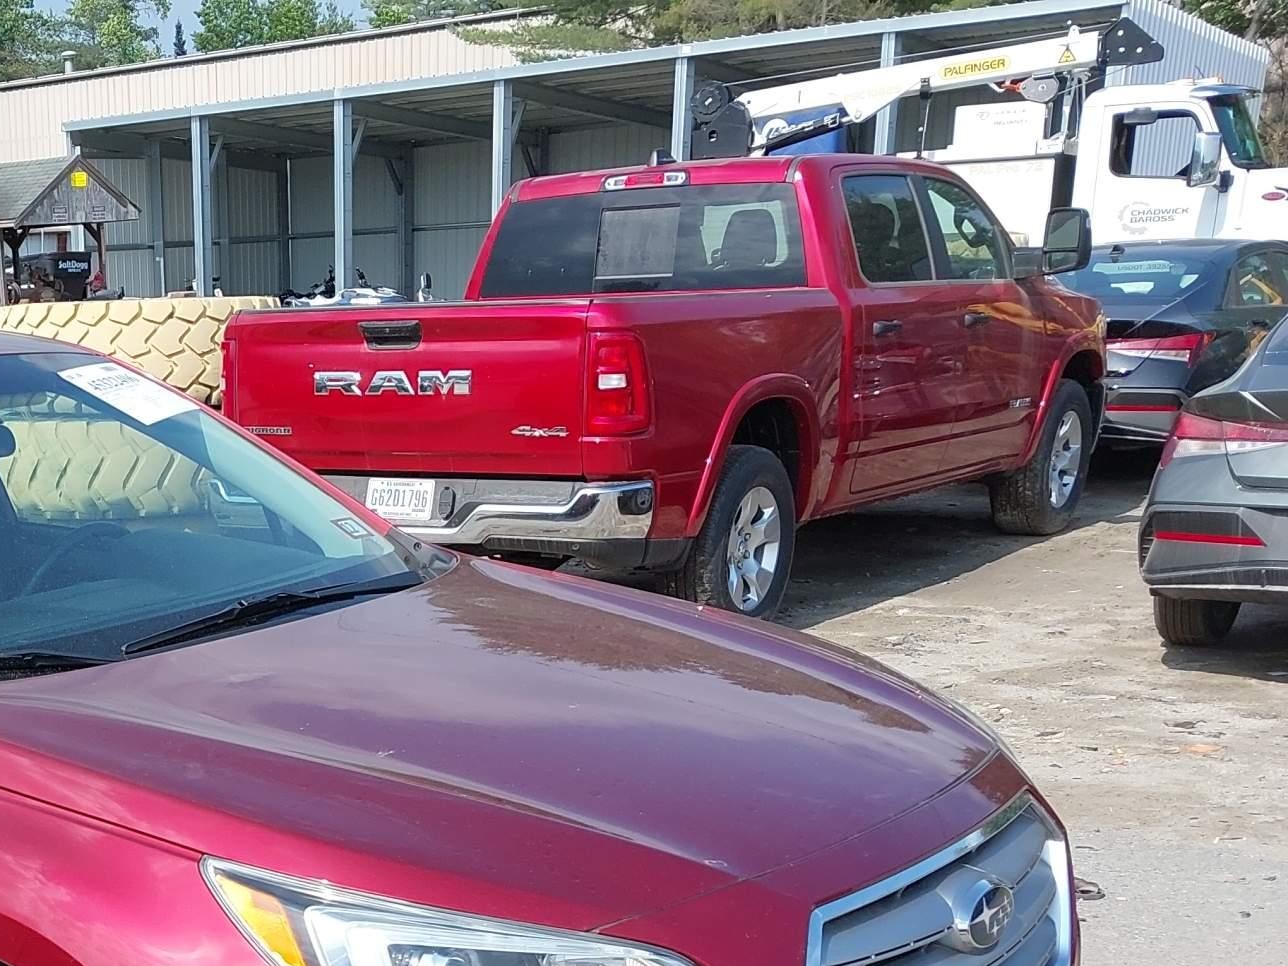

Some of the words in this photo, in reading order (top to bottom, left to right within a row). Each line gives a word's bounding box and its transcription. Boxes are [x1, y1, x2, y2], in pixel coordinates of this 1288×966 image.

[944, 59, 1005, 77] PALFINGER
[1131, 207, 1190, 217] CHADWICK
[313, 370, 472, 396] RAM
